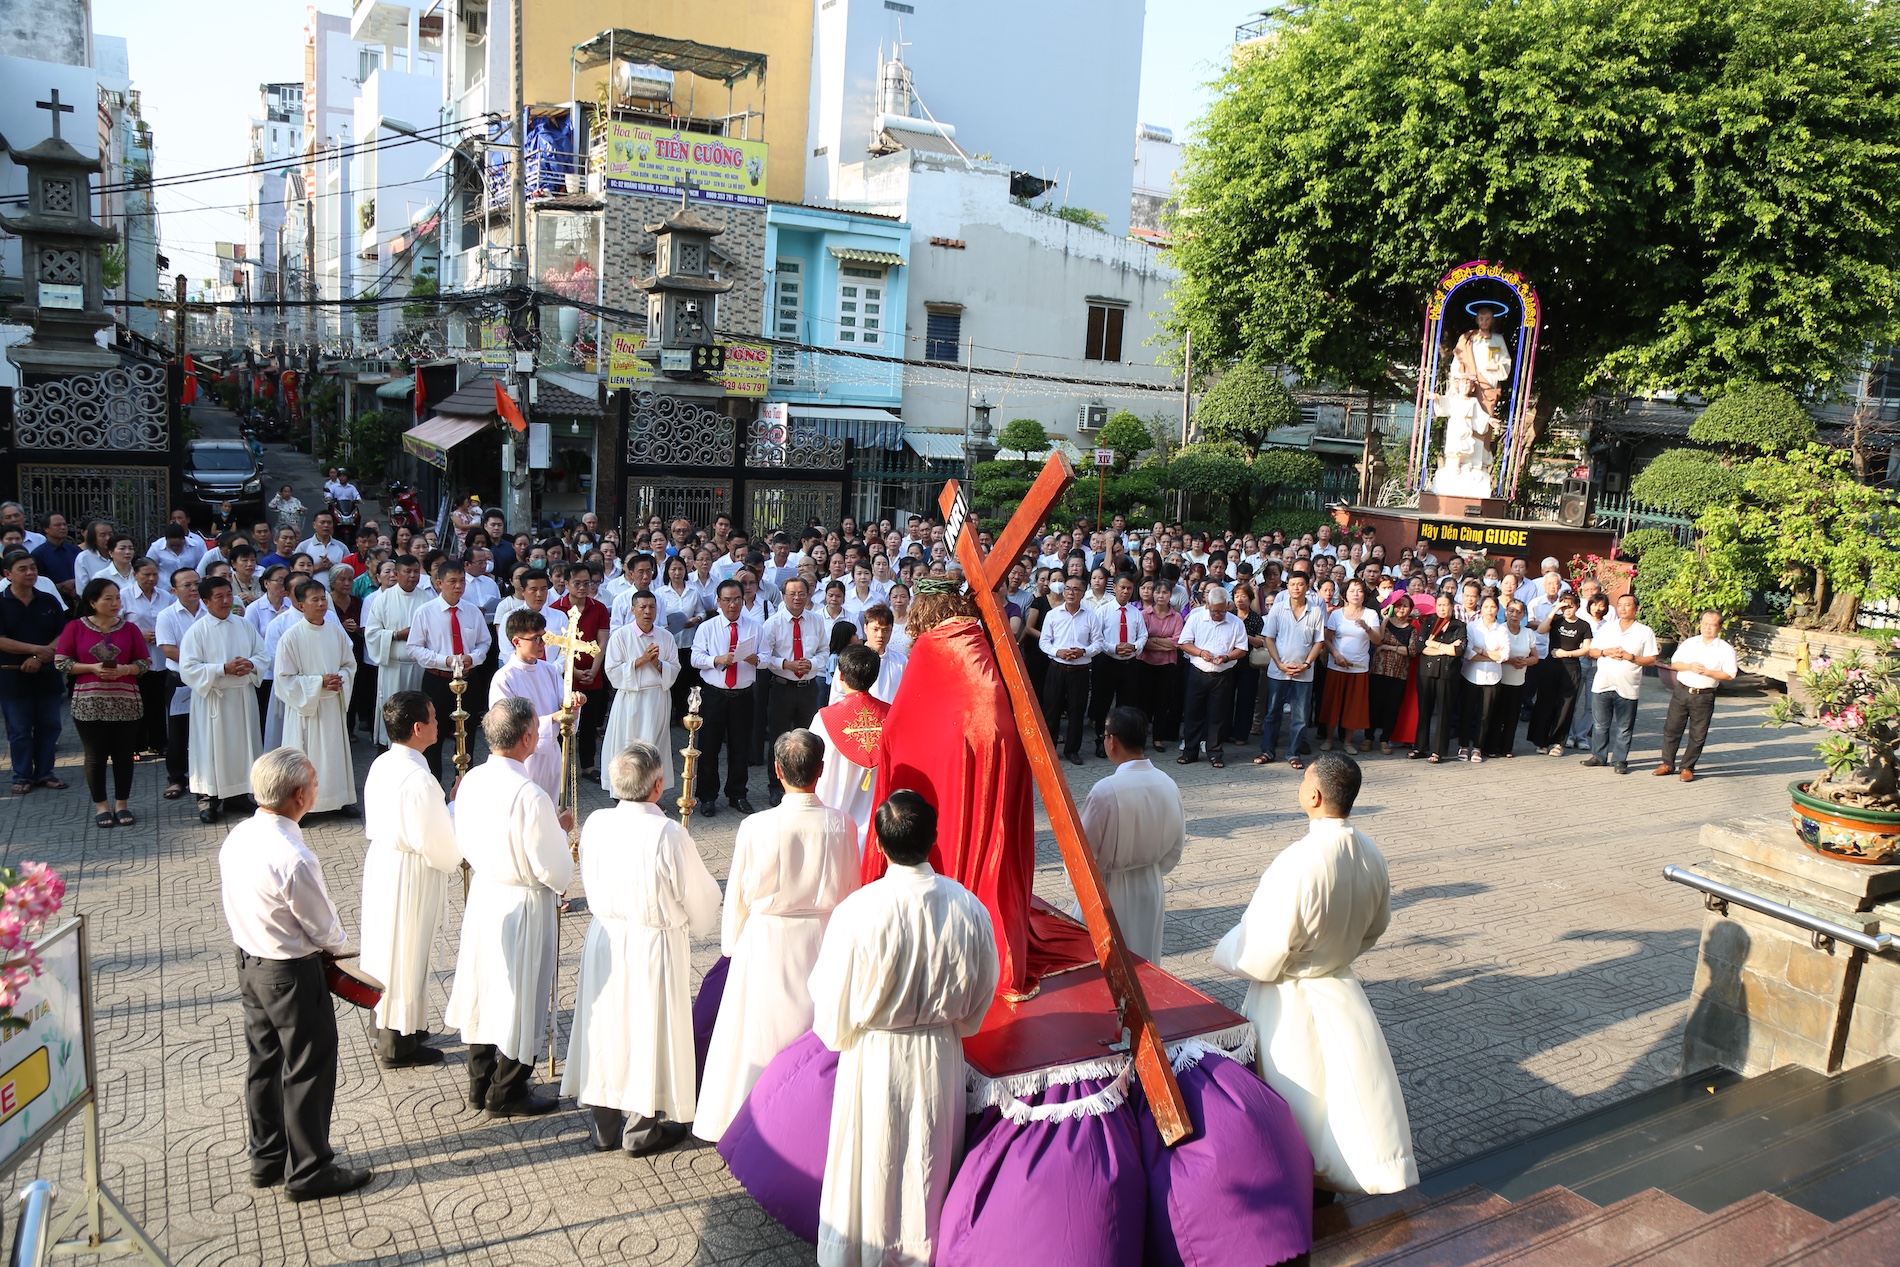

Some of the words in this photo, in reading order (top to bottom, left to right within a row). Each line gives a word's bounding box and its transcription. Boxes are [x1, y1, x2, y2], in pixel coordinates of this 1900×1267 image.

[613, 125, 630, 138] Hoa
[633, 127, 652, 141] Tươi
[655, 132, 690, 162] TIẾN
[693, 141, 743, 168] CƯỜNG
[1517, 283, 1537, 328] GIUSE
[614, 338, 635, 354] Hoa
[724, 345, 767, 362] ƯỜNG
[611, 375, 625, 384] LIÊN
[738, 382, 750, 391] 445
[753, 383, 765, 391] 791
[762, 406, 771, 418] Hoa
[1097, 455, 1111, 464] XIV
[944, 493, 966, 553] INRI
[1421, 523, 1439, 541] Hãy
[1440, 523, 1458, 541] Đến
[1460, 526, 1484, 544] Cùng
[1485, 528, 1528, 546] GIUSE
